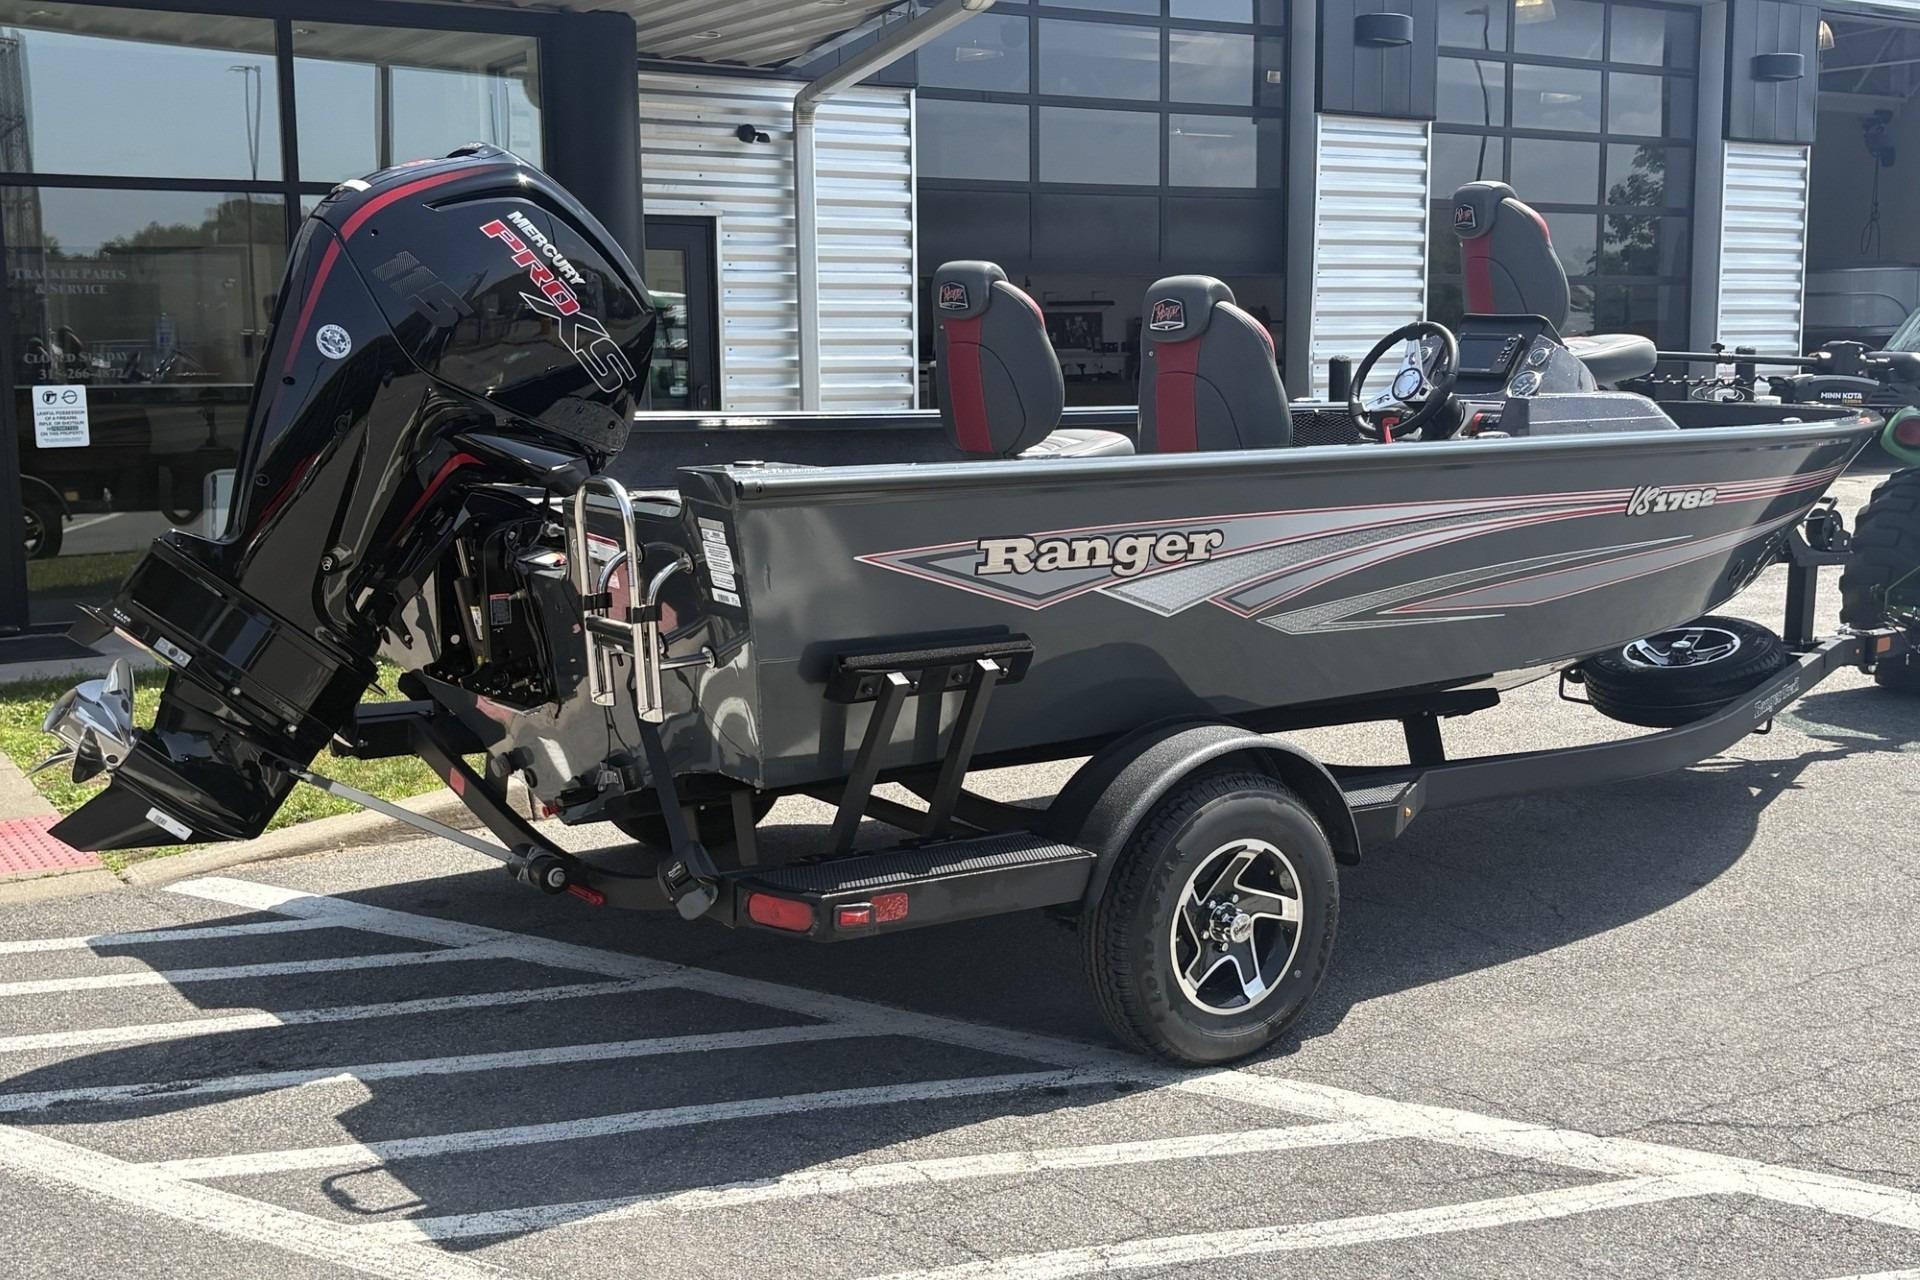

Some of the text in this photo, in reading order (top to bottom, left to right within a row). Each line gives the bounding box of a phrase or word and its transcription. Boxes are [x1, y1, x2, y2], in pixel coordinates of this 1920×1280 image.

[507, 211, 586, 284] MERCURY
[80, 267, 127, 280] PARTS
[479, 219, 581, 316] PRO
[49, 283, 108, 295] SERVICE
[23, 353, 76, 364] CLOED
[1820, 391, 1863, 400] MINN KOTA
[976, 528, 1225, 577] Ranger
